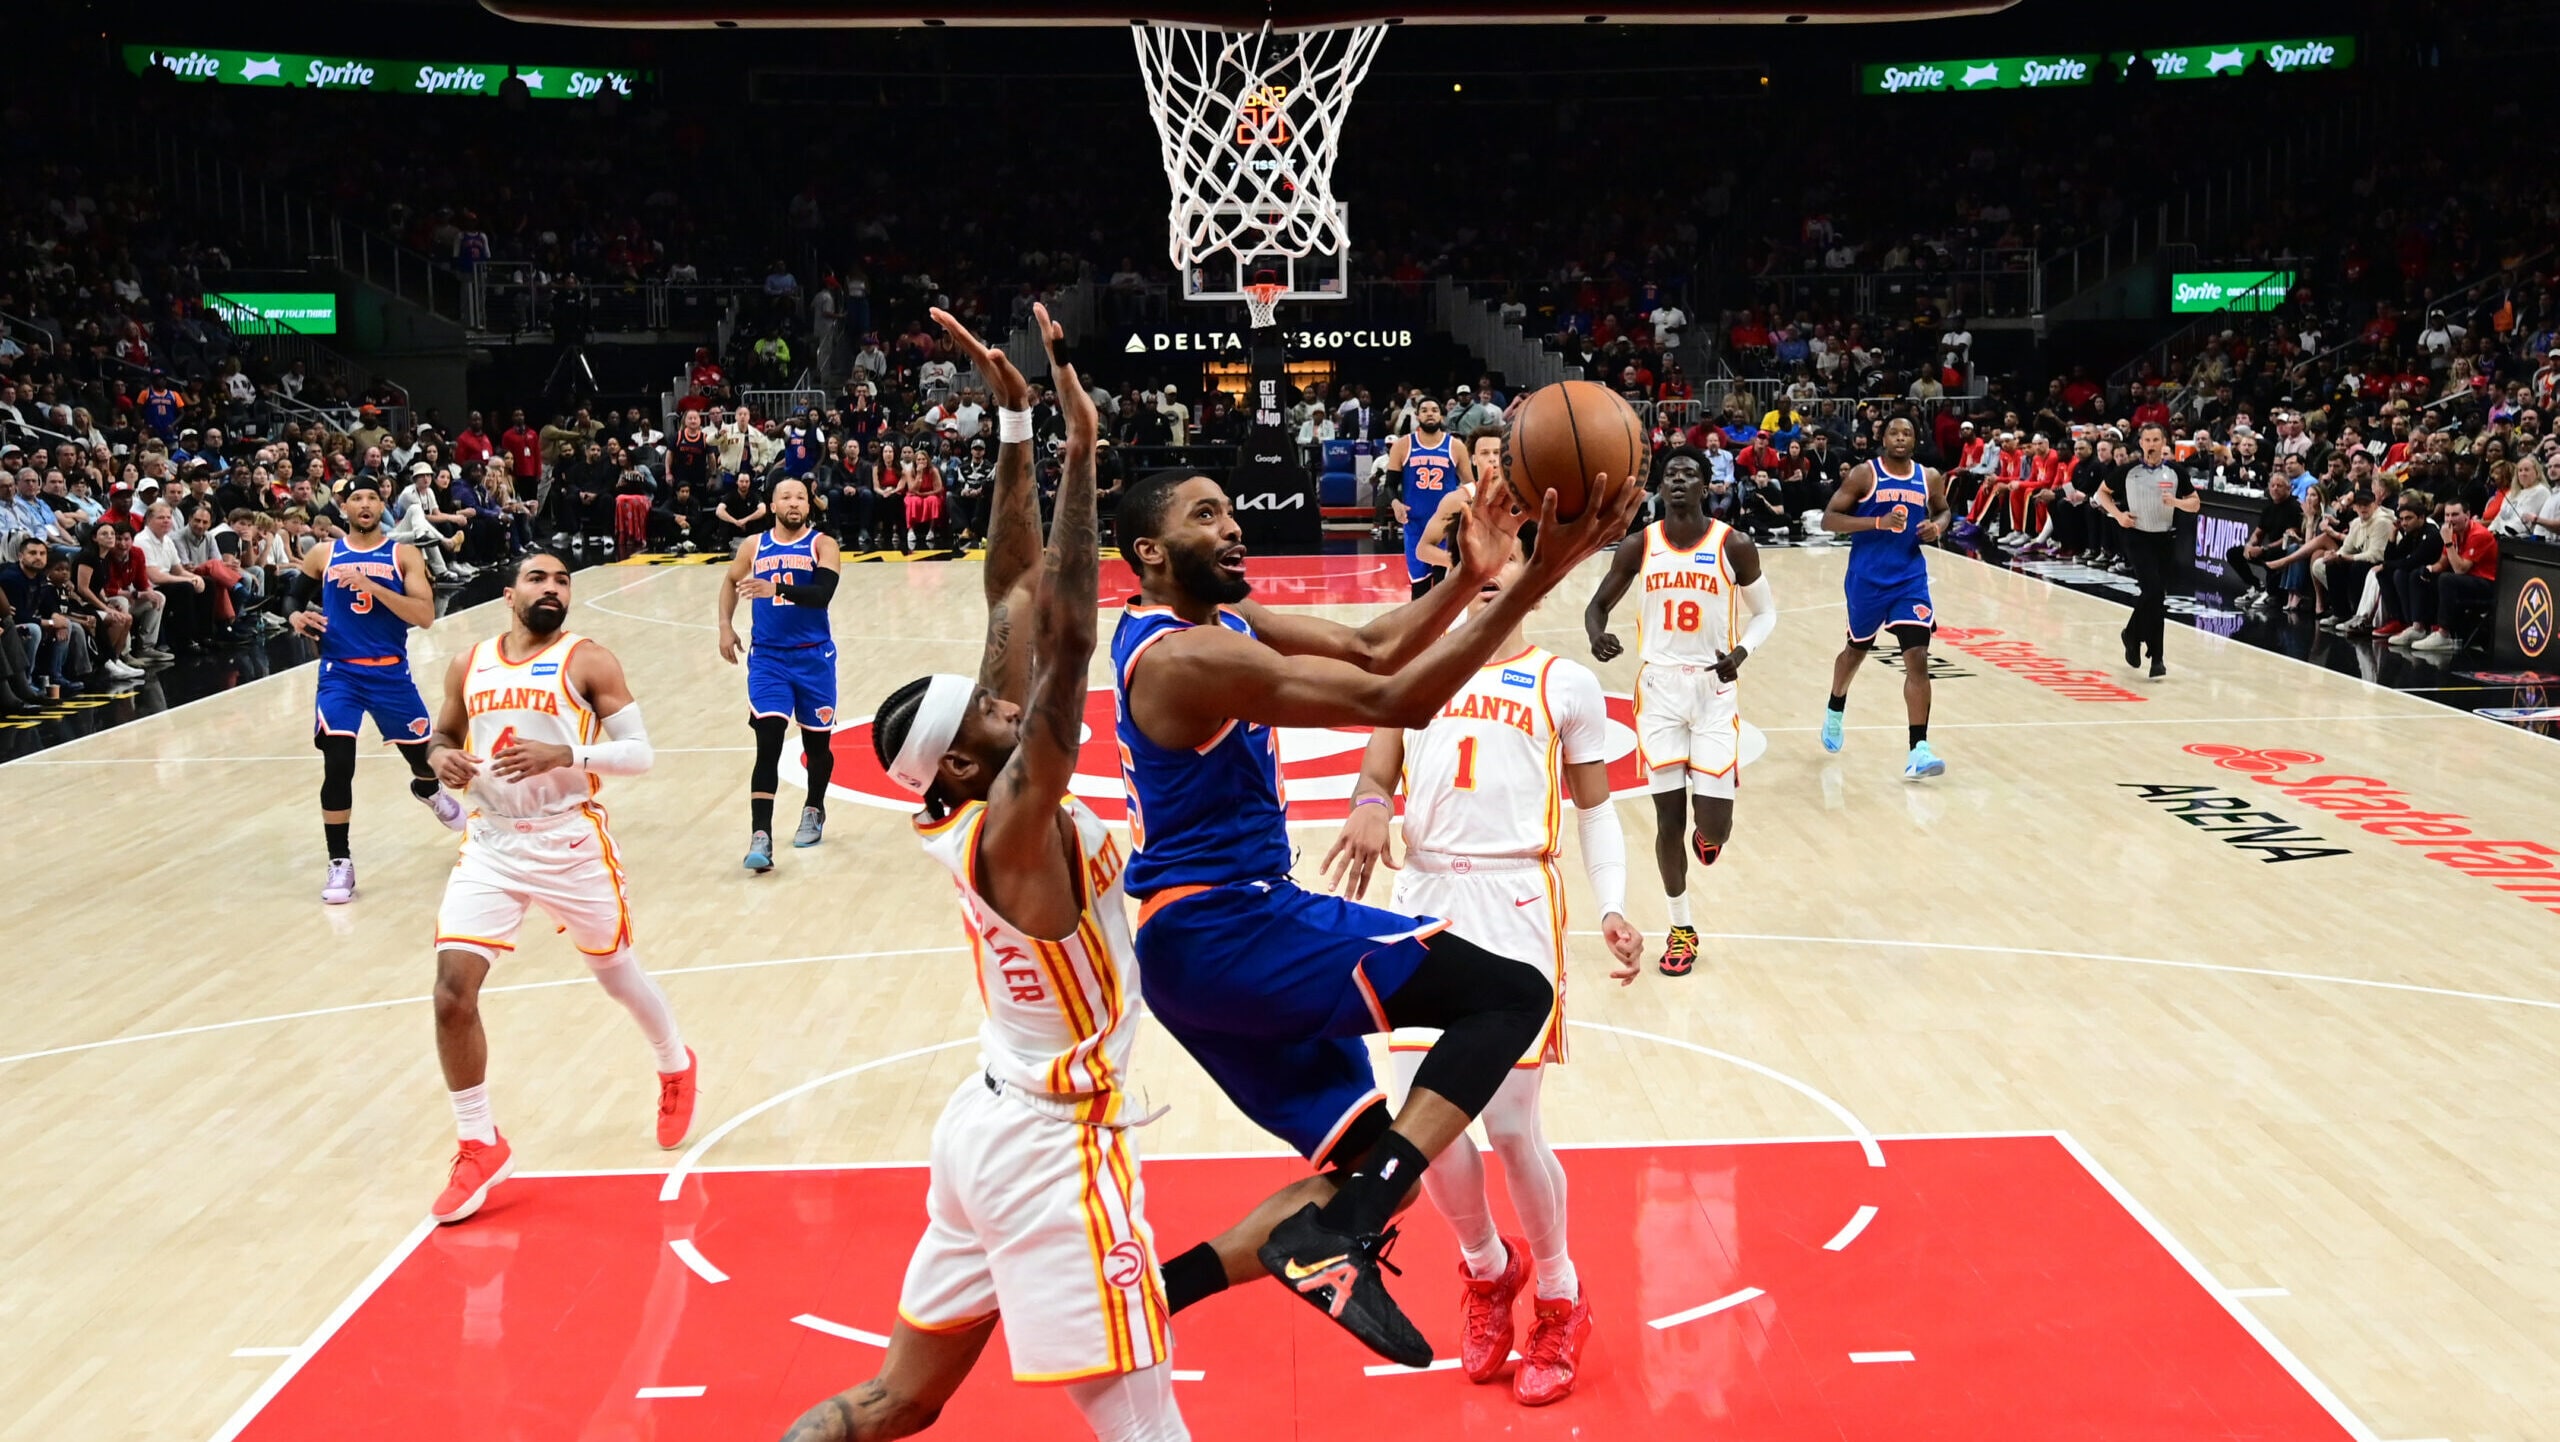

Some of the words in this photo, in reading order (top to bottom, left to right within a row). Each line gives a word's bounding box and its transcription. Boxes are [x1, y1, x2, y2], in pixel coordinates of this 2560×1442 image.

[150, 51, 220, 77] prite
[2267, 42, 2334, 72] Sprite
[305, 60, 374, 88] Sprite
[415, 65, 485, 93] Sprite
[566, 71, 632, 98] Sprte
[1880, 65, 1944, 93] Sprite
[2020, 58, 2086, 86] Sprite
[2175, 282, 2222, 304] Sprite
[1154, 332, 1242, 351] DELTA
[1260, 380, 1276, 394] GET
[1260, 395, 1276, 409] THE
[1264, 410, 1281, 427] App
[1255, 453, 1282, 464] Google
[1416, 467, 1444, 490] 32
[1236, 493, 1304, 510] KIA
[2204, 516, 2249, 562] PLAYOFFS
[755, 555, 782, 576] NEW
[779, 554, 814, 571] YORK
[2206, 559, 2224, 578] Google
[1646, 571, 1718, 595] ATLANTA
[1664, 600, 1701, 632] 18
[1503, 672, 1534, 685] paze
[469, 688, 559, 719] ATLANTA
[1431, 693, 1534, 737] LANTA
[1454, 736, 1477, 791] 1
[2116, 782, 2353, 864] ARENA
